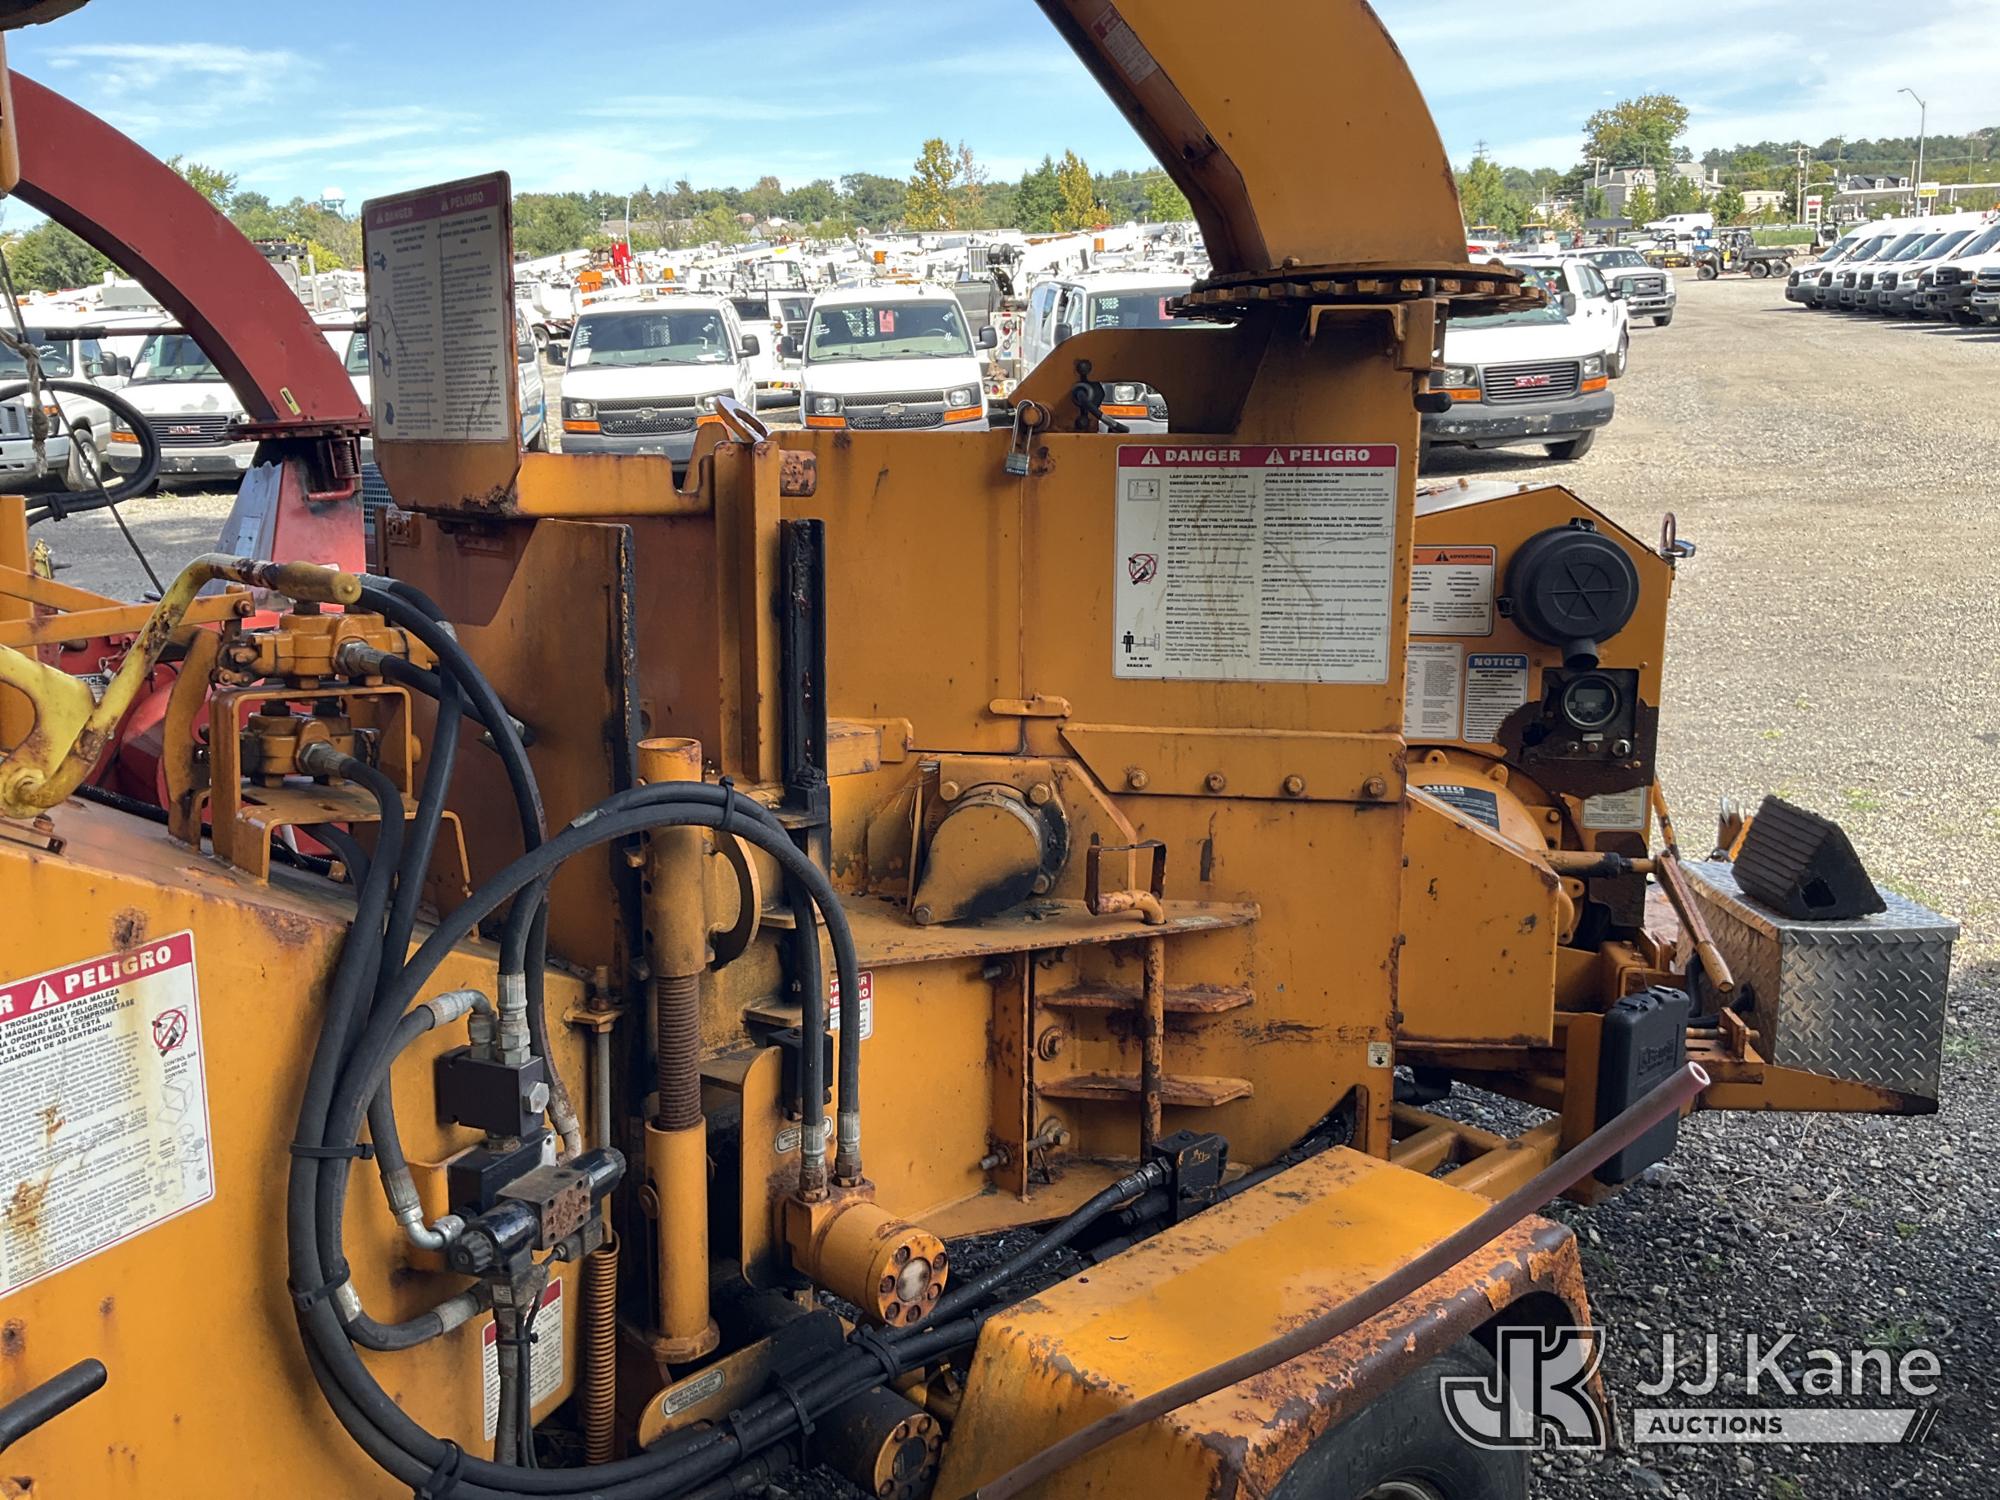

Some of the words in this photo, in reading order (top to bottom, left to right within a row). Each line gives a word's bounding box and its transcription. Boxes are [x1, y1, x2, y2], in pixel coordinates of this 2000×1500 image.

[449, 191, 484, 209] PELIGRO
[1165, 449, 1241, 462] DANGER
[1289, 449, 1371, 462] PELIGRO
[1474, 657, 1521, 667] NOTICE
[64, 945, 172, 995] PELIGRO
[5, 1005, 65, 1031] TROCEADORAS
[66, 998, 88, 1013] PARA
[89, 988, 120, 1006] MALEZA
[5, 1018, 53, 1039] MÁQUINAS
[50, 1012, 69, 1025] MUY
[70, 997, 118, 1018] PELIGROSAS
[11, 1028, 46, 1045] OPERAR!
[47, 1024, 64, 1036] LEA
[73, 998, 135, 1024] COMPROMÉTASE
[0, 1046, 42, 1064] LCAMONÍA
[44, 1041, 55, 1050] DE
[57, 1021, 113, 1045] ADVERTENCIA!
[7, 1047, 18, 1055] EL
[20, 1030, 67, 1052] CONTENIDO
[68, 1024, 80, 1033] DE
[80, 1018, 102, 1030] ESTÁ
[163, 1055, 187, 1067] CONTROL
[164, 1069, 187, 1080] CONTROL
